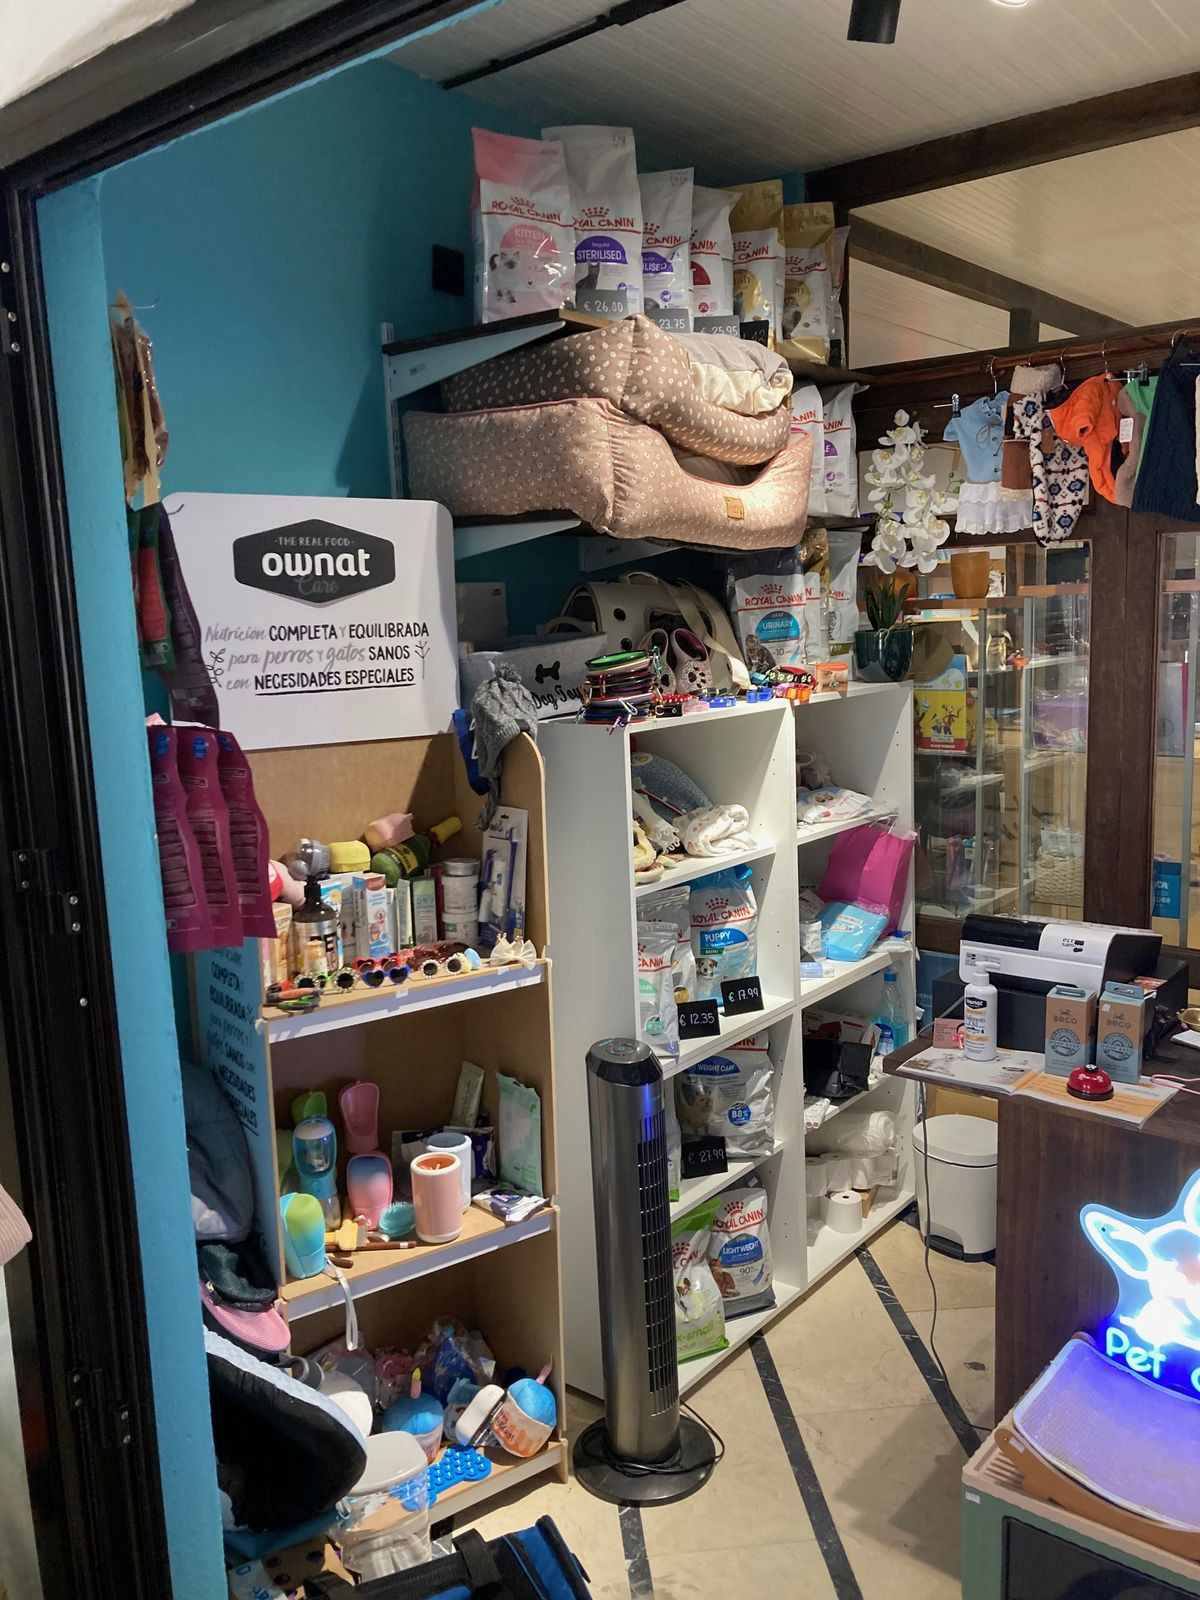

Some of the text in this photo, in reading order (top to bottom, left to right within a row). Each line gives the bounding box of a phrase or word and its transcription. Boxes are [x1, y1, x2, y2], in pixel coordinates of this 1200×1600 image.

[492, 200, 560, 222] ROYAL CANIN
[573, 216, 634, 228] OYAL CANIN
[646, 235, 682, 246] CANIN
[691, 240, 717, 250] ANIN
[576, 250, 622, 260] STERILISED
[738, 246, 769, 260] CANIN
[790, 262, 822, 272] CANIN
[584, 301, 591, 312] €
[660, 318, 686, 329] 23.75
[792, 410, 817, 422] ANIN
[824, 420, 844, 430] ANIN
[278, 537, 350, 547] THE REAL FOOD
[261, 548, 371, 577] ownat
[294, 575, 340, 596] Care
[744, 593, 803, 607] ROYAL CANIN
[205, 624, 266, 642] Nutrición
[269, 624, 338, 642] COMPLETA
[348, 622, 430, 639] EQUILIBRADA
[762, 620, 794, 630] URINARY
[228, 651, 261, 672] para
[264, 647, 314, 672] perros
[326, 642, 366, 676] gatos
[368, 644, 410, 661] SANOS
[226, 667, 414, 691] con NECESIDADES ESPECIALES
[531, 690, 558, 710] Dog
[692, 906, 750, 924] ROYAL CANIN
[704, 931, 730, 942] PUPPY
[728, 987, 758, 1002] € 17.99
[679, 1012, 714, 1026] € 12.35
[688, 1149, 724, 1164] € 27.99
[739, 1209, 764, 1226] CANIN
[1106, 1326, 1166, 1379] Pet
